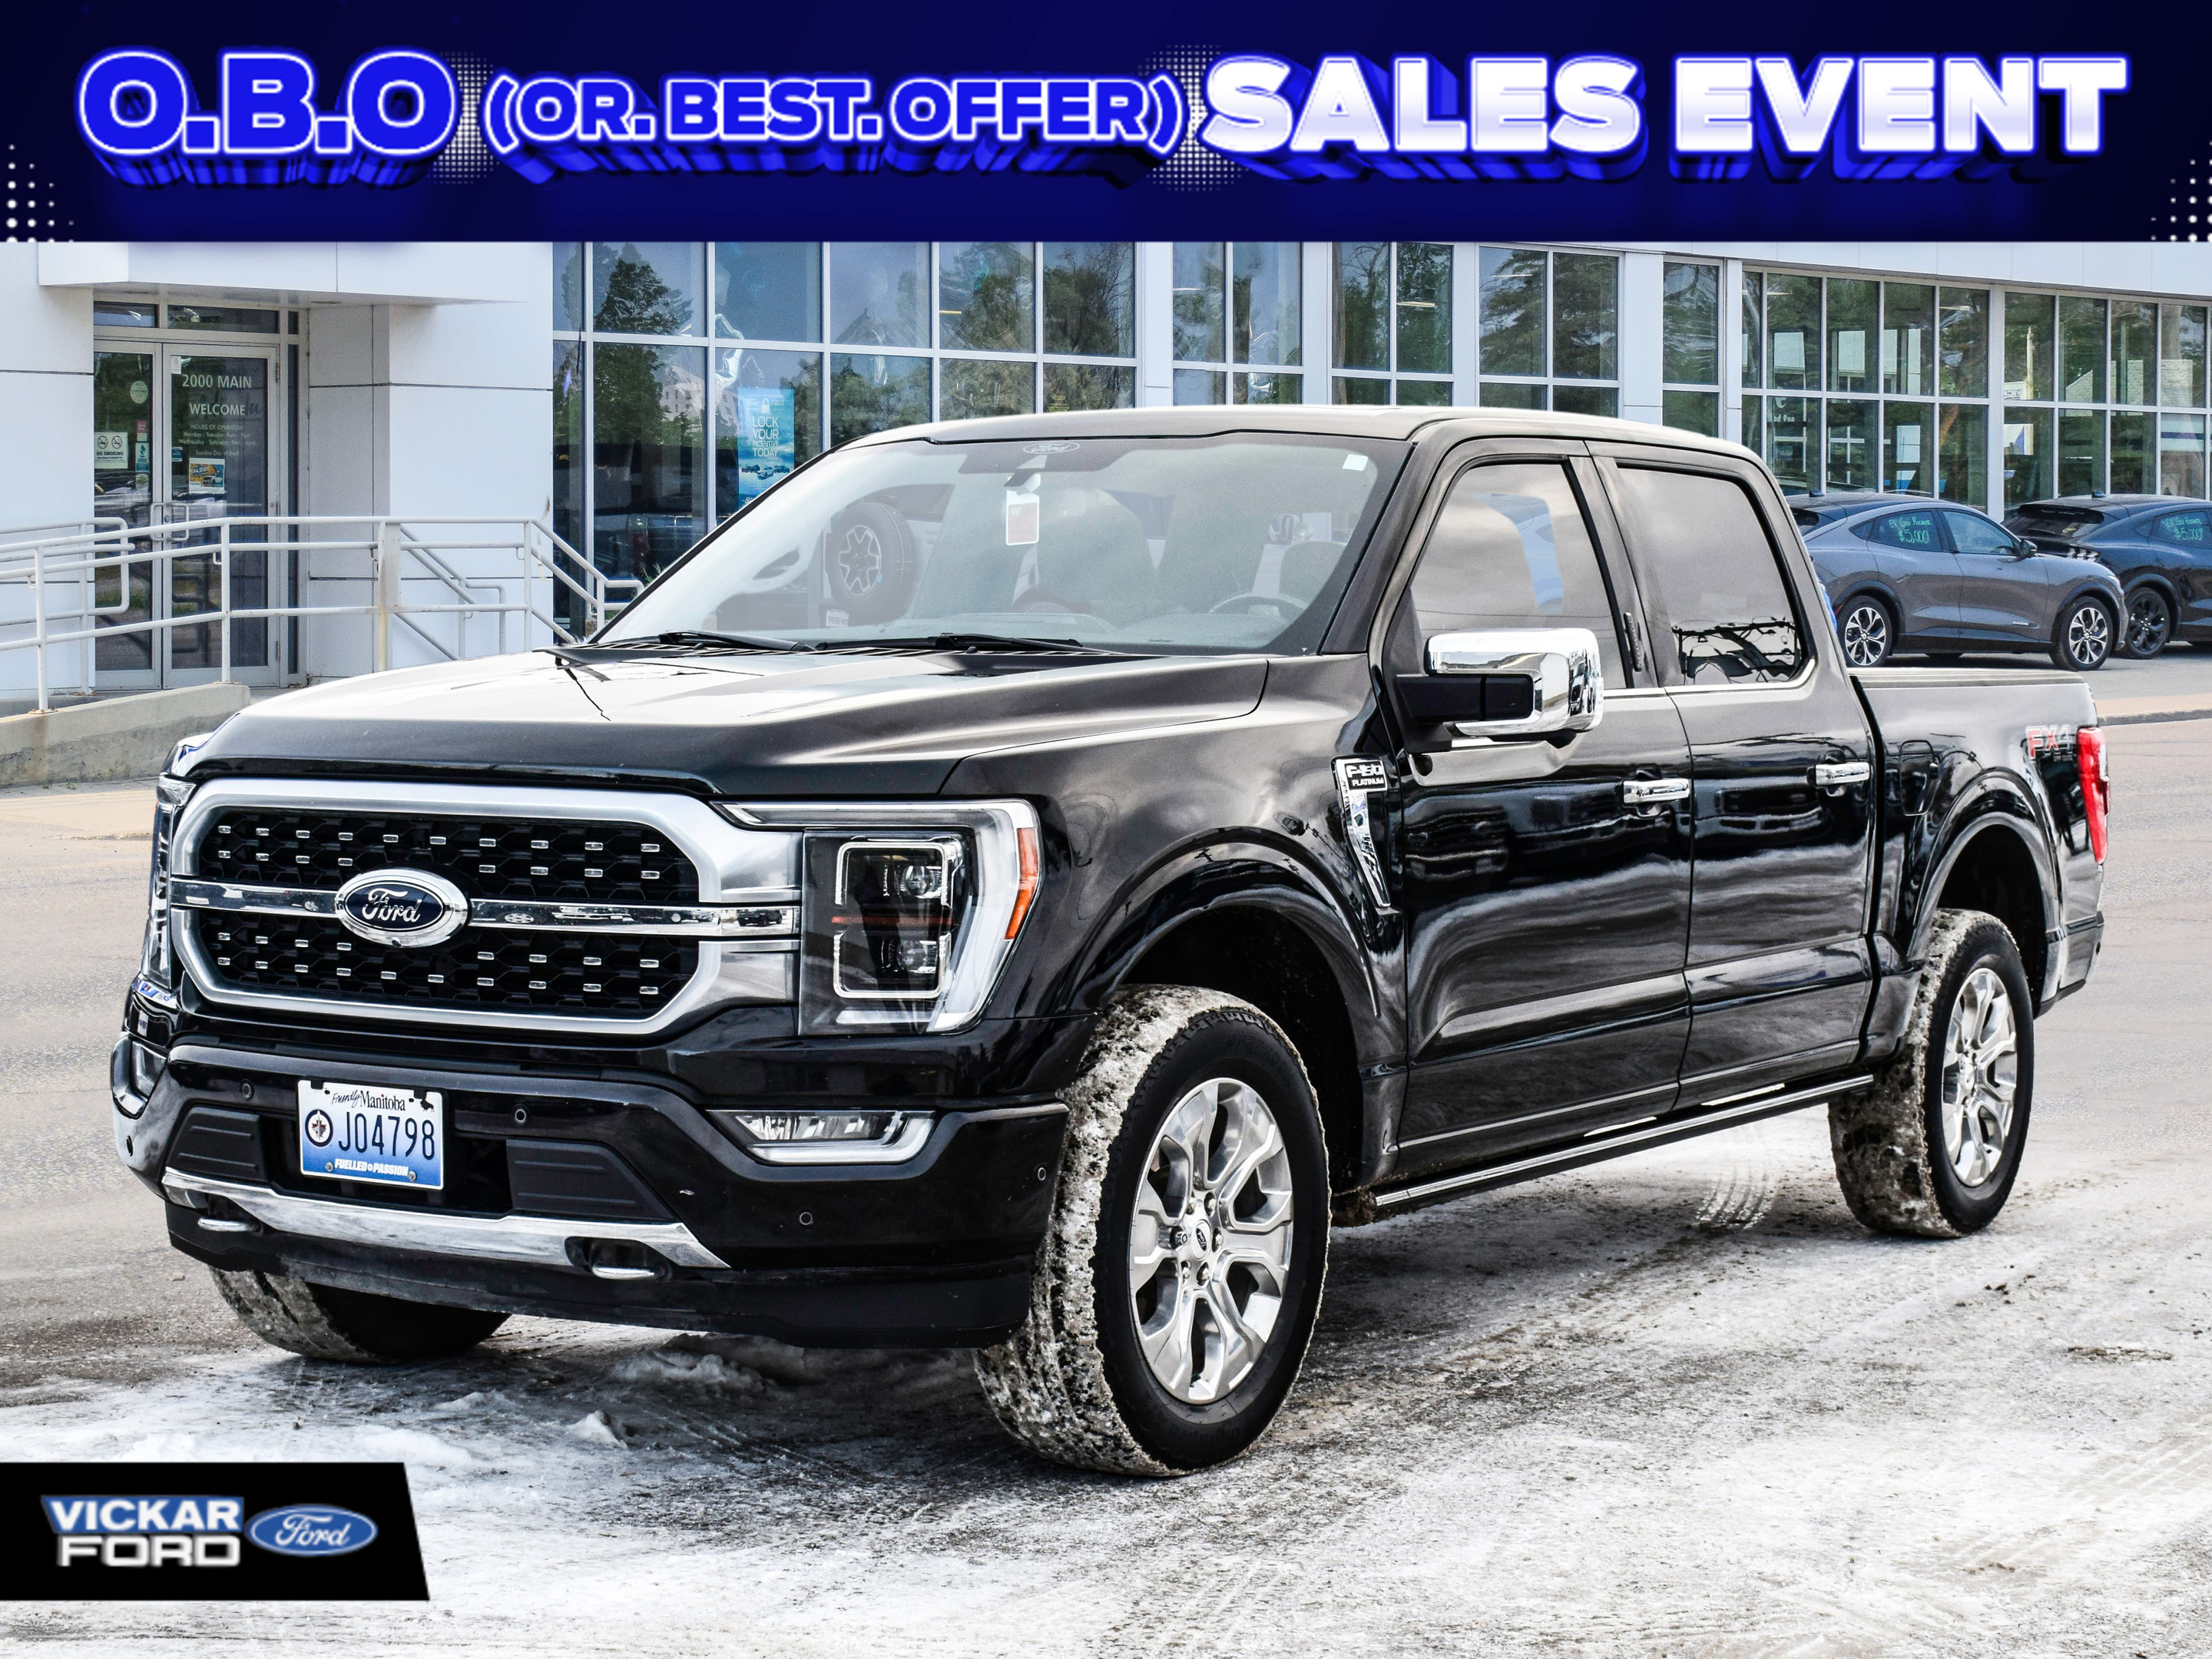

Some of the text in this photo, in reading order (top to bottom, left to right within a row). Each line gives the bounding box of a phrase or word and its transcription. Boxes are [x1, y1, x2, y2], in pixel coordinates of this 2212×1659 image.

[182, 374, 252, 389] 2000 MAIN
[189, 403, 246, 416] WELCOME
[752, 416, 779, 428] LOCK
[752, 429, 780, 440] YOUR
[752, 448, 778, 457] TODAY
[1898, 528, 1930, 544] $5,000
[2025, 725, 2073, 762] FX4
[1351, 777, 1385, 786] PLATINUM
[362, 887, 422, 922] Ford
[331, 1089, 406, 1111] Friendly Manitoba
[334, 1157, 368, 1172] FUELLED
[373, 1162, 409, 1177] PASSION
